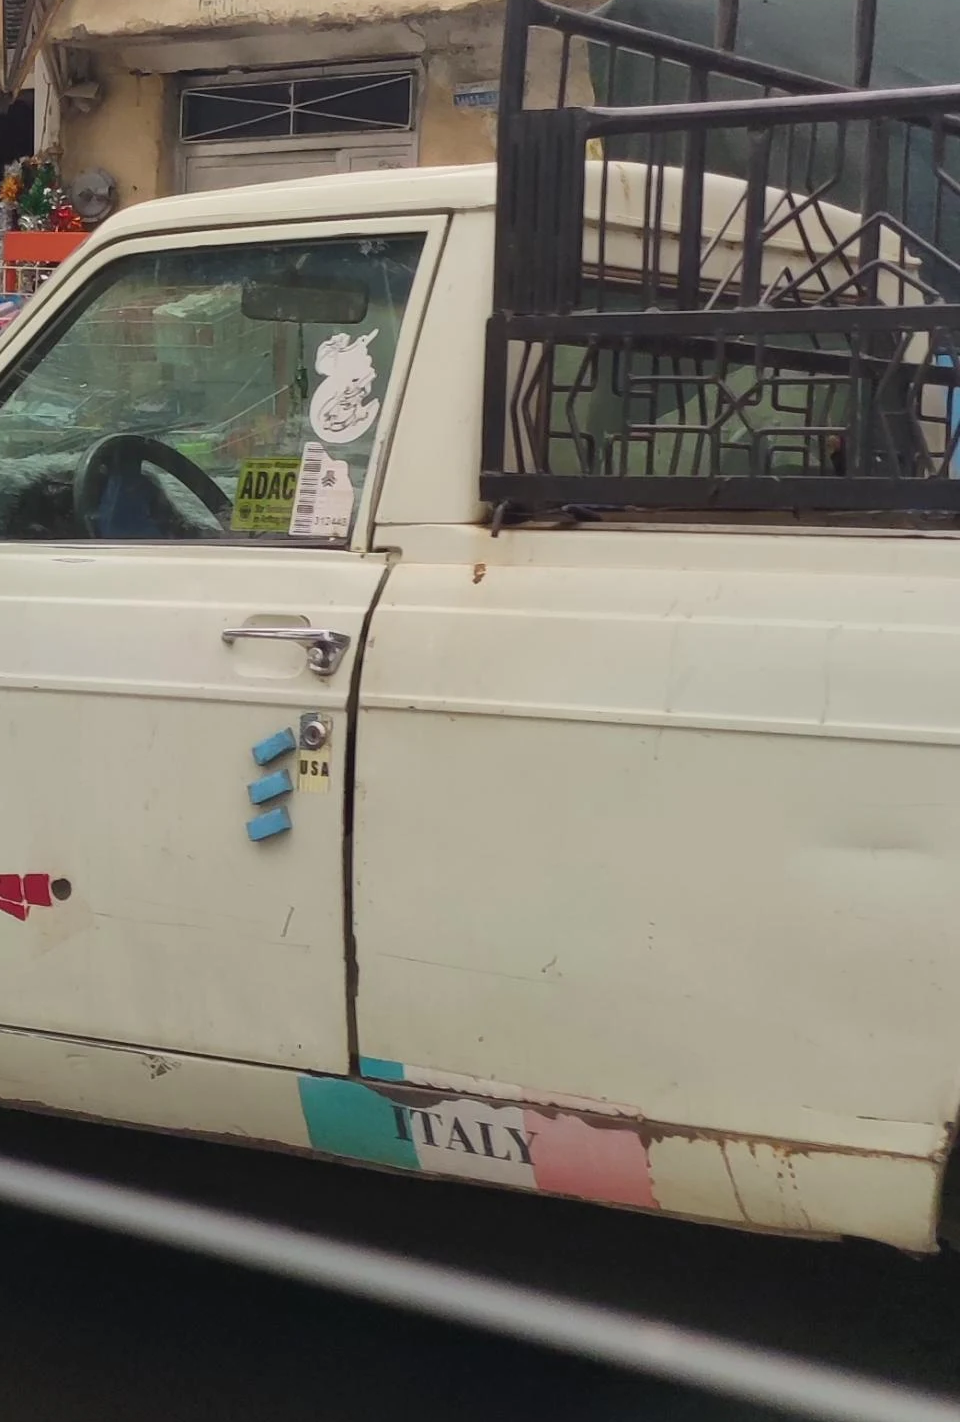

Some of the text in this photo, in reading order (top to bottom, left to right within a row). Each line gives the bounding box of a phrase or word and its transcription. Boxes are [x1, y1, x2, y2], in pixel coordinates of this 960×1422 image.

[239, 471, 297, 500] ADAC
[299, 759, 330, 778] USA
[391, 1105, 538, 1166] ITALY
